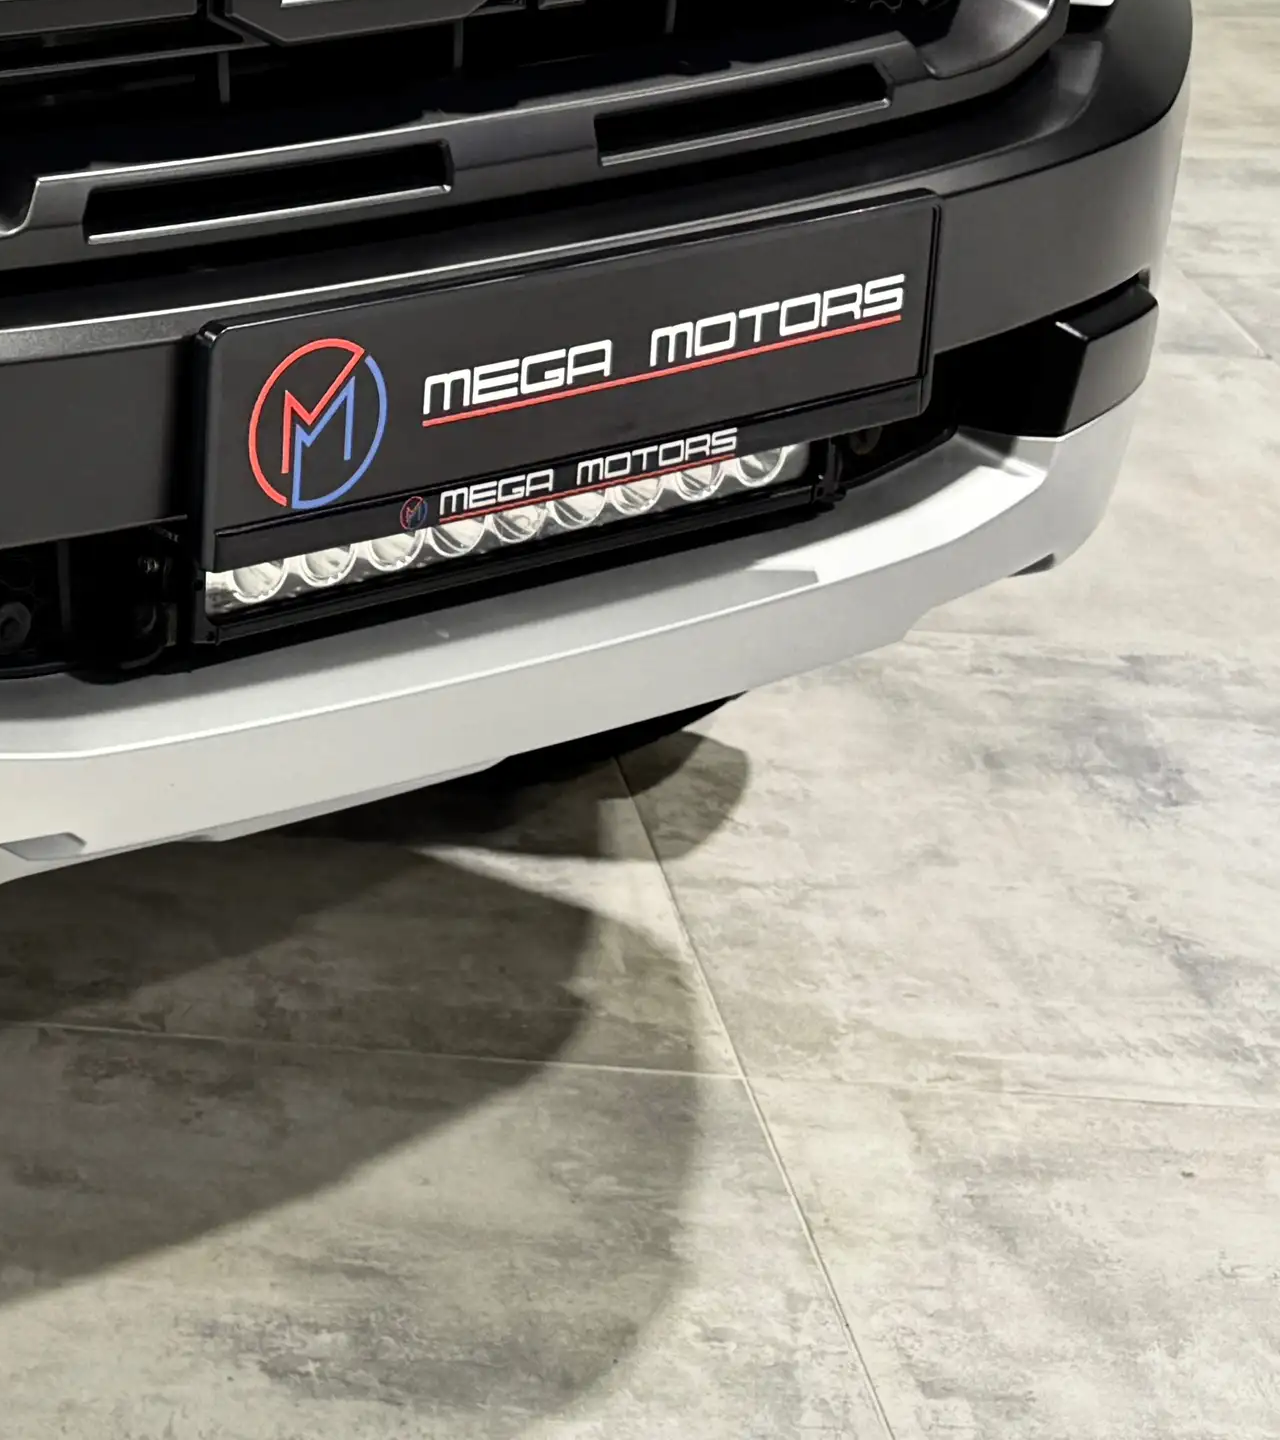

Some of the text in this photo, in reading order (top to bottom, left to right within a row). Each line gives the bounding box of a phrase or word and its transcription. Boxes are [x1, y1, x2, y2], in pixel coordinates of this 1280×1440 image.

[422, 339, 613, 415] MEGA
[649, 273, 906, 367] MOTORS
[439, 468, 554, 515] MEGA
[576, 427, 738, 485] MOTORS
